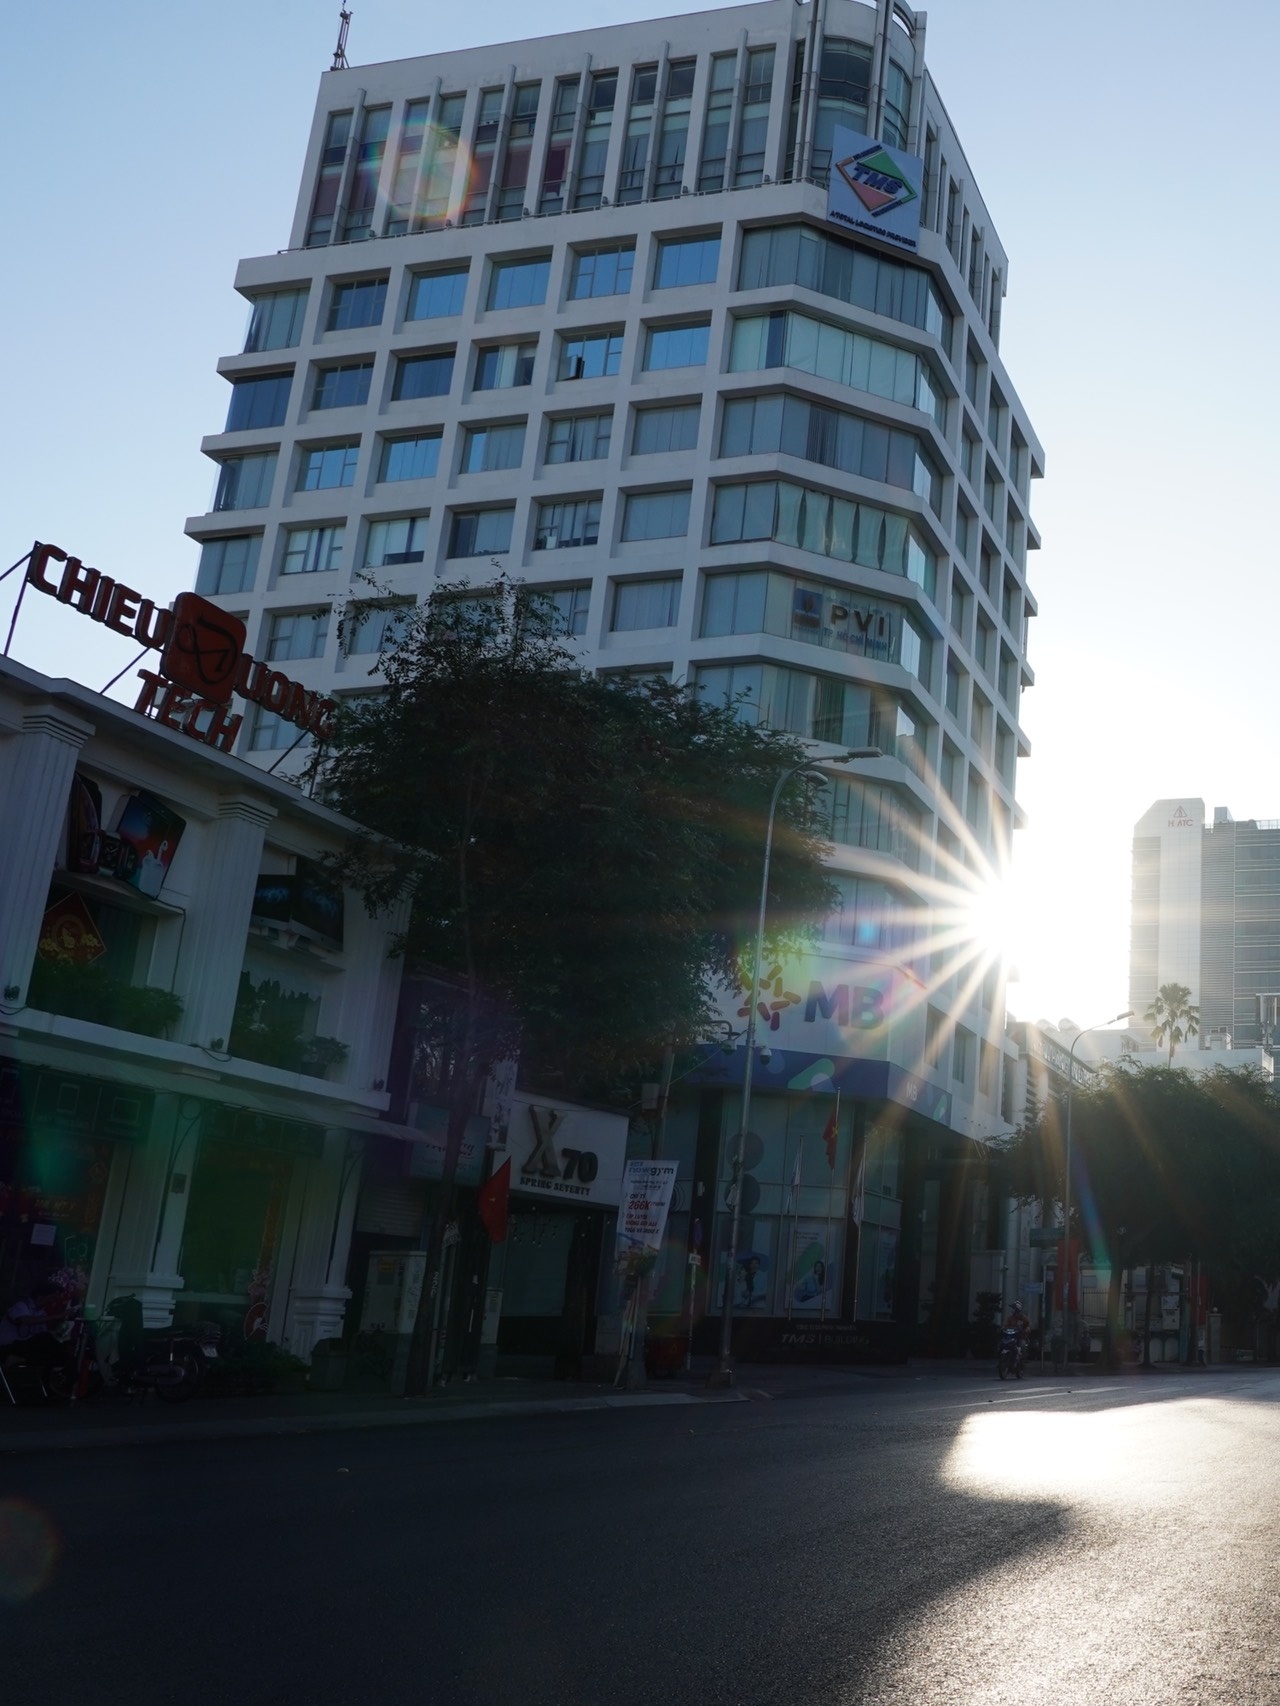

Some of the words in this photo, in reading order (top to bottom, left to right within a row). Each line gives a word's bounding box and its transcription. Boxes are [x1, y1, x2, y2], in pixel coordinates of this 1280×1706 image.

[852, 164, 903, 195] TMS
[30, 542, 172, 650] CHIEU
[830, 604, 885, 637] PVI
[135, 668, 243, 753] TECH
[803, 980, 884, 1030] MB
[906, 1081, 918, 1101] MB
[520, 1175, 552, 1189] SPRING
[781, 1333, 817, 1344] TMS
